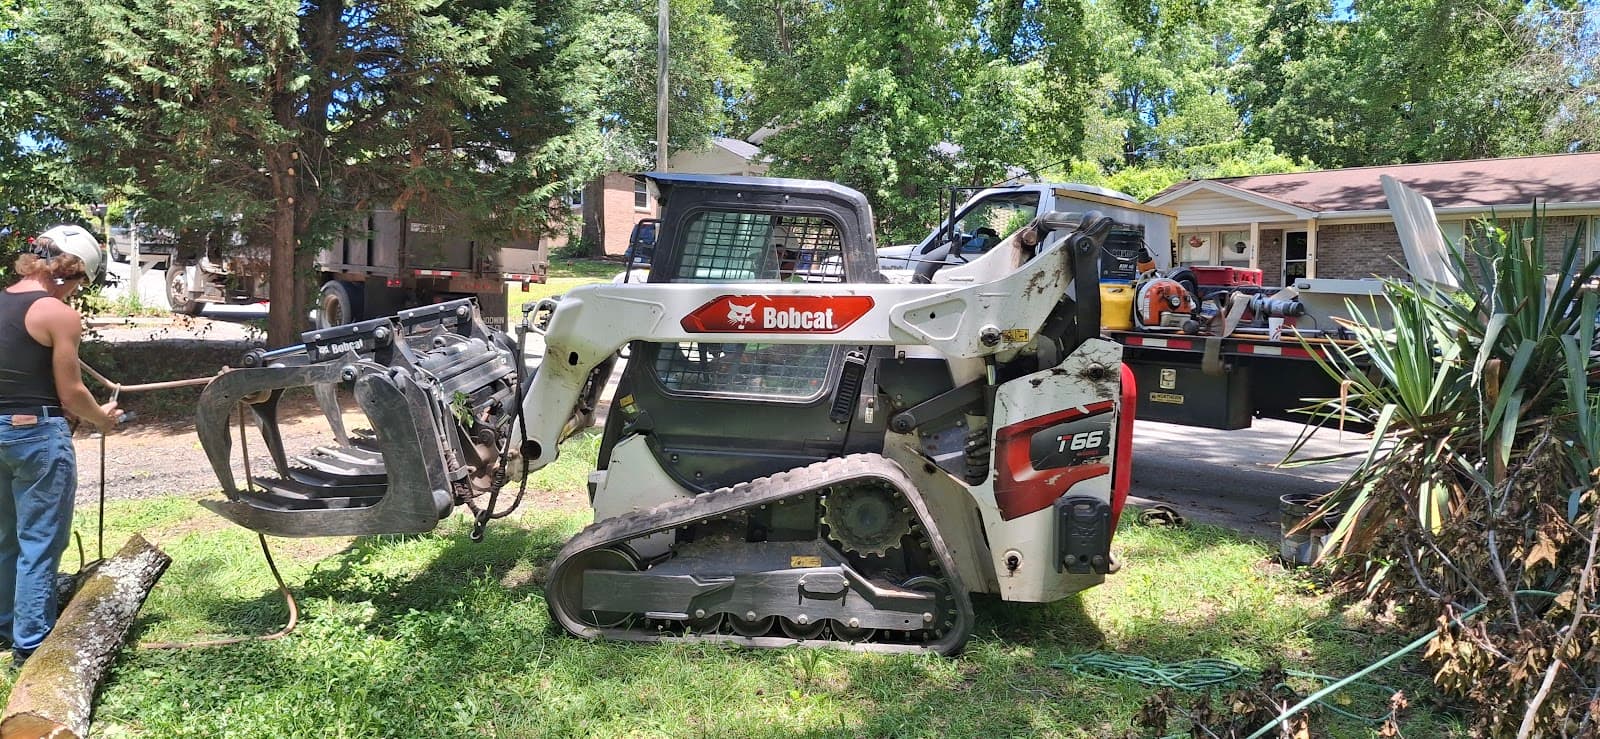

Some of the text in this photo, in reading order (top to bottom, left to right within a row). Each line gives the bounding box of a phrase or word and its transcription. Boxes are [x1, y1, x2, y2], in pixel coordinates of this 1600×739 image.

[763, 307, 834, 329] Bobcat
[331, 338, 363, 354] Bobcat
[1057, 430, 1104, 453] T66
